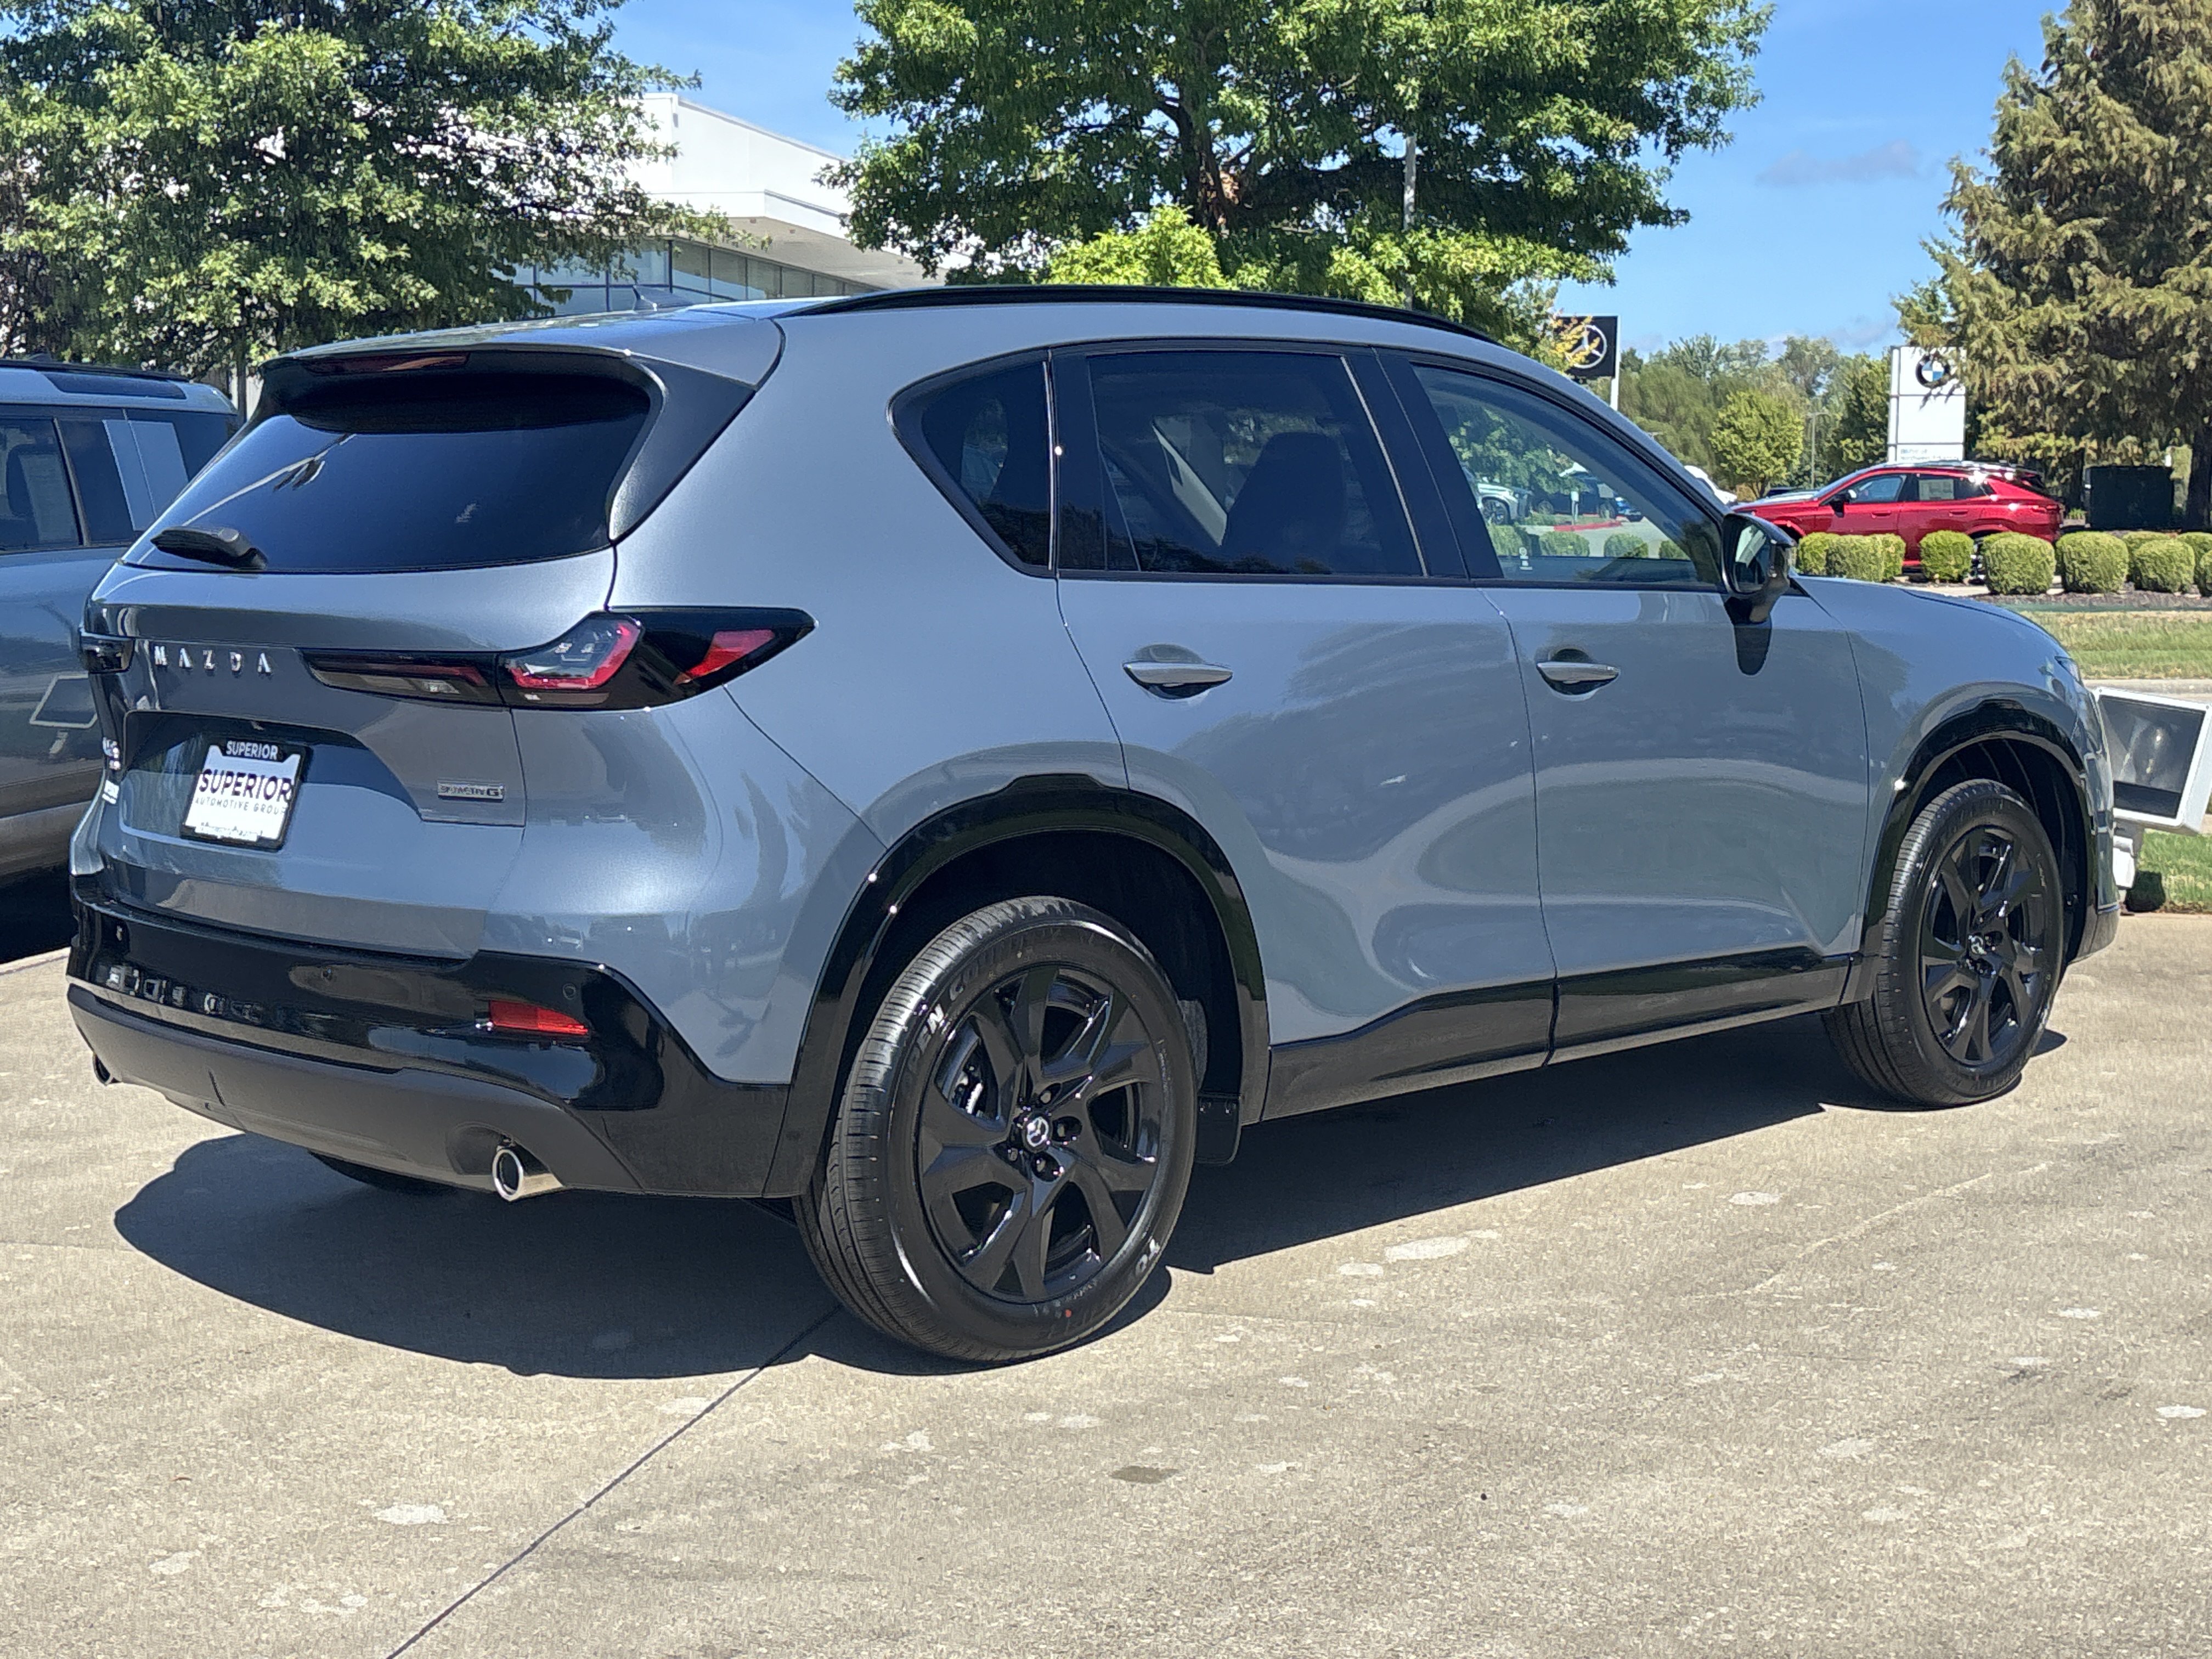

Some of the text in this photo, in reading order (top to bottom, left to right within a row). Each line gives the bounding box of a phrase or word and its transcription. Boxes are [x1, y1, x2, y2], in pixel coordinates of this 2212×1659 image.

[153, 645, 273, 674] MAZDA
[225, 740, 278, 760] SUPERIOR
[199, 768, 293, 804] SUPERIOR
[195, 796, 249, 811] AUTOMOTIVE
